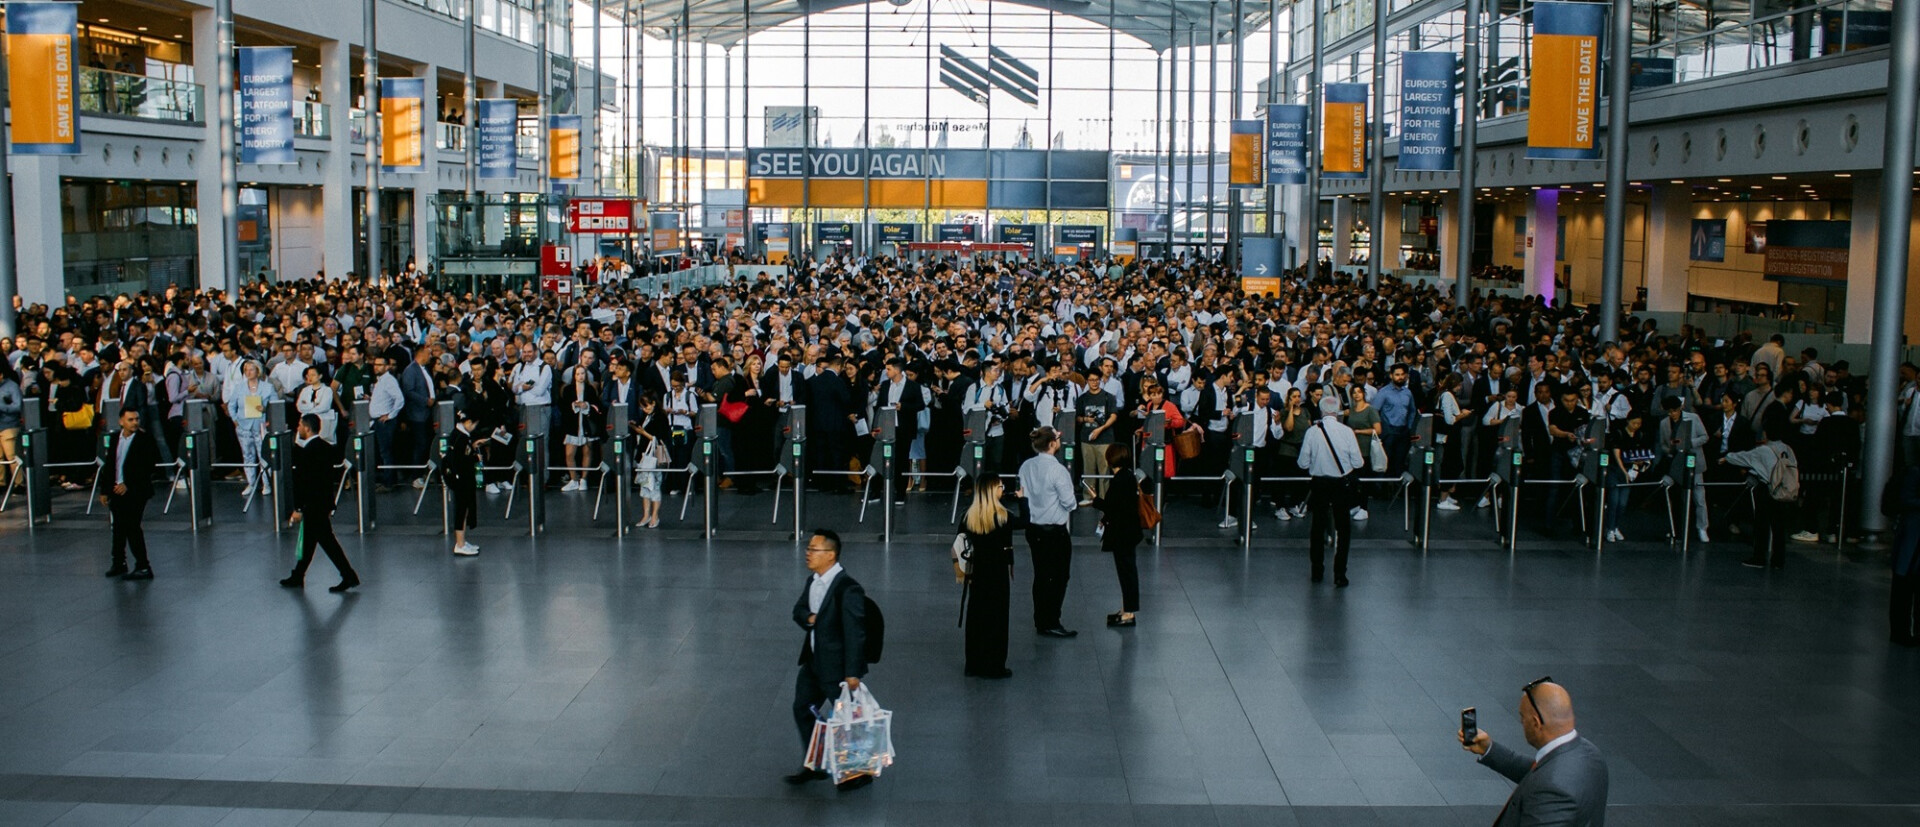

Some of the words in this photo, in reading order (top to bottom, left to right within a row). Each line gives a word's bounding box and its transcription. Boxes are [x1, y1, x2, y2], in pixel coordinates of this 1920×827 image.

[56, 38, 68, 71] DATE
[1579, 40, 1592, 75] DATE
[243, 75, 284, 84] EUROPE'S
[1404, 80, 1448, 88] EUROPE'S
[57, 75, 69, 101] THE
[243, 88, 280, 96] LARGEST
[1578, 78, 1590, 104] THE
[1404, 93, 1443, 101] LARGEST
[244, 101, 288, 109] PLATFORM
[1404, 106, 1450, 115] PLATFORM
[58, 104, 70, 137] SAVE
[244, 114, 260, 122] FOR
[262, 114, 279, 122] THE
[1404, 120, 1422, 128] FOR
[1424, 120, 1440, 128] THE
[1576, 107, 1589, 142] SAVE
[244, 127, 278, 135] ENERGY
[1354, 129, 1362, 145] THE
[1404, 132, 1438, 140] ENERGY
[244, 140, 286, 148] INDUSTRY
[1403, 146, 1446, 154] INDUSTRY
[1353, 147, 1361, 169] SAVE
[757, 153, 802, 175] SEE
[809, 153, 859, 175] YOU
[869, 154, 945, 176] AGAIN
[1768, 262, 1790, 273] VISITOR
[1790, 263, 1832, 276] REGISTRATION
